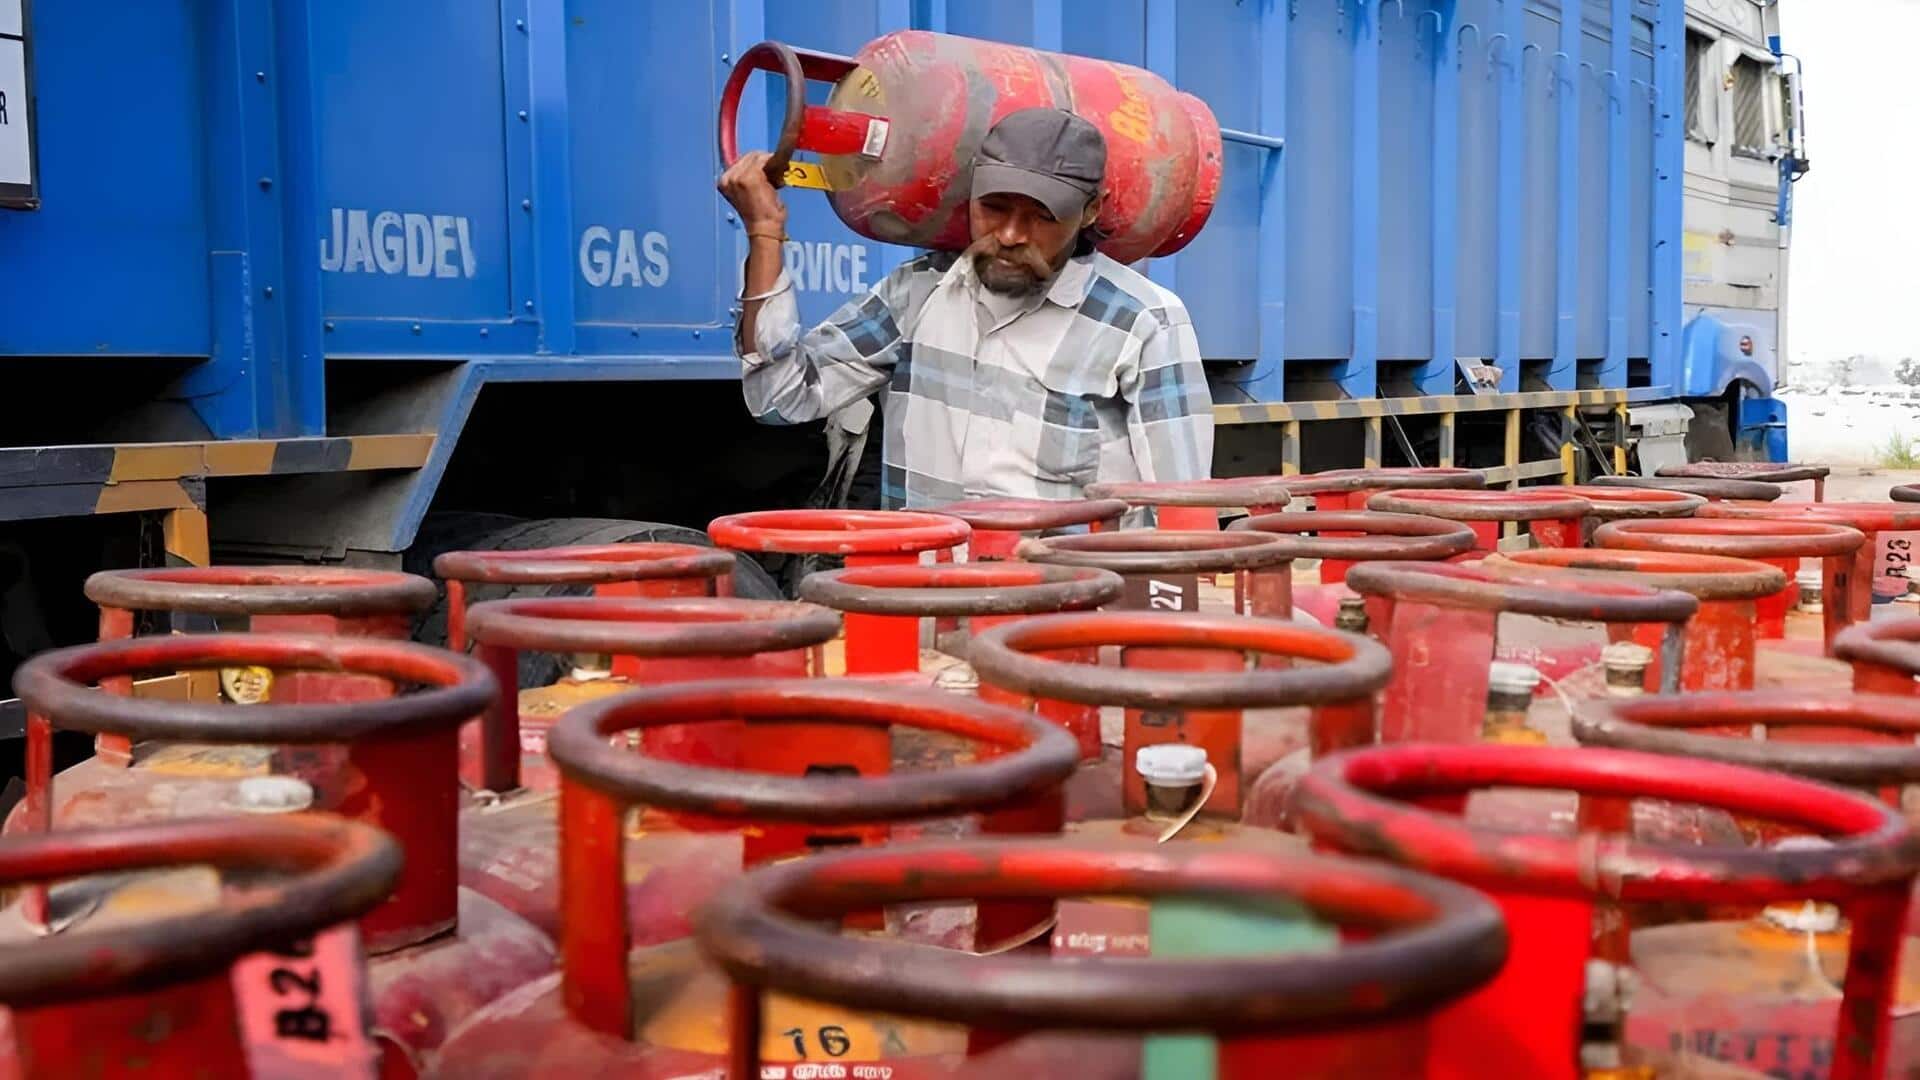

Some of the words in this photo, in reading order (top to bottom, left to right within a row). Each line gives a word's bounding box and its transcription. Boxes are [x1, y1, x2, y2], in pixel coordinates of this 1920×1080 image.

[579, 225, 670, 288] GAS
[782, 240, 868, 294] RVICE
[1149, 579, 1183, 611] 27
[783, 1025, 851, 1059] 16
